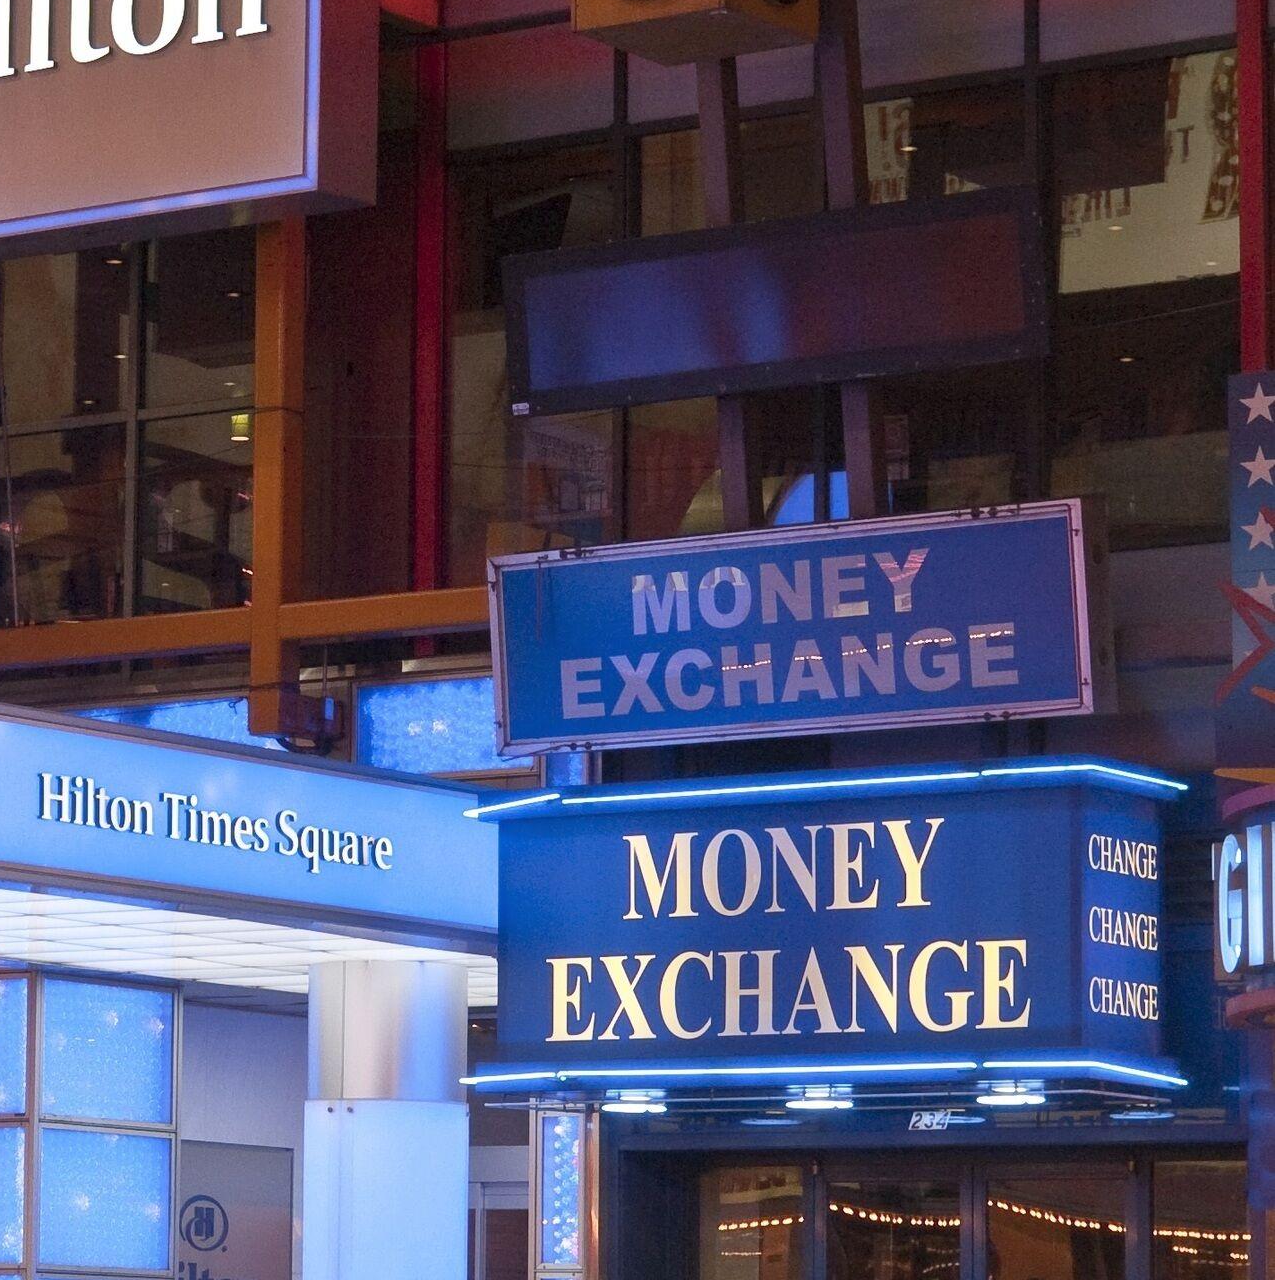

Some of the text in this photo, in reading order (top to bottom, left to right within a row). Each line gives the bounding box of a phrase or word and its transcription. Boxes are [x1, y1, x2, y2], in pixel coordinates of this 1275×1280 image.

[631, 548, 931, 636] MONEY
[560, 622, 1019, 720] EXCHANGE
[37, 772, 395, 874] Hilton Times Square
[622, 816, 945, 921] MONEY
[1087, 833, 1158, 881] CHANGE
[1088, 905, 1158, 952] CHANGE
[1218, 821, 1275, 974] GI
[545, 938, 1032, 1044] EXCHANGE
[1088, 976, 1159, 1021] CHANGE
[911, 1111, 950, 1129] 234
